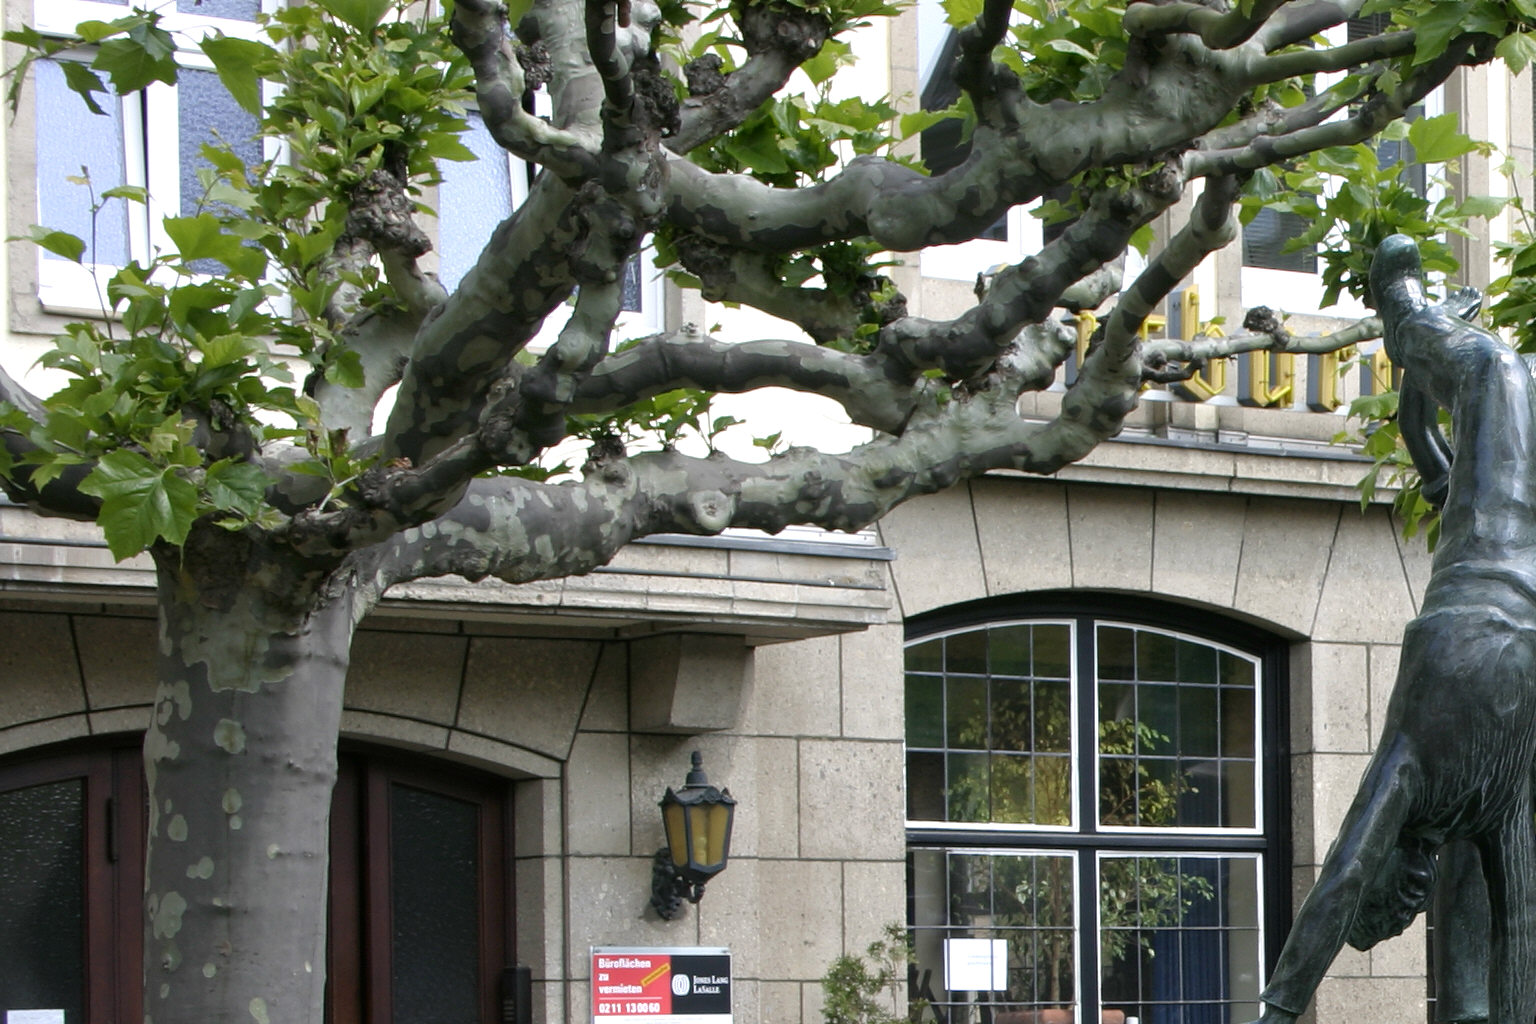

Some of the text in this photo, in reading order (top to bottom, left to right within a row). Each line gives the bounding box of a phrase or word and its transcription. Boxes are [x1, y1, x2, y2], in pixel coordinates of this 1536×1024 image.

[598, 957, 651, 969] Büroflächen
[598, 973, 609, 981] zu
[598, 983, 643, 994] vermieten
[598, 1002, 622, 1013] 0211
